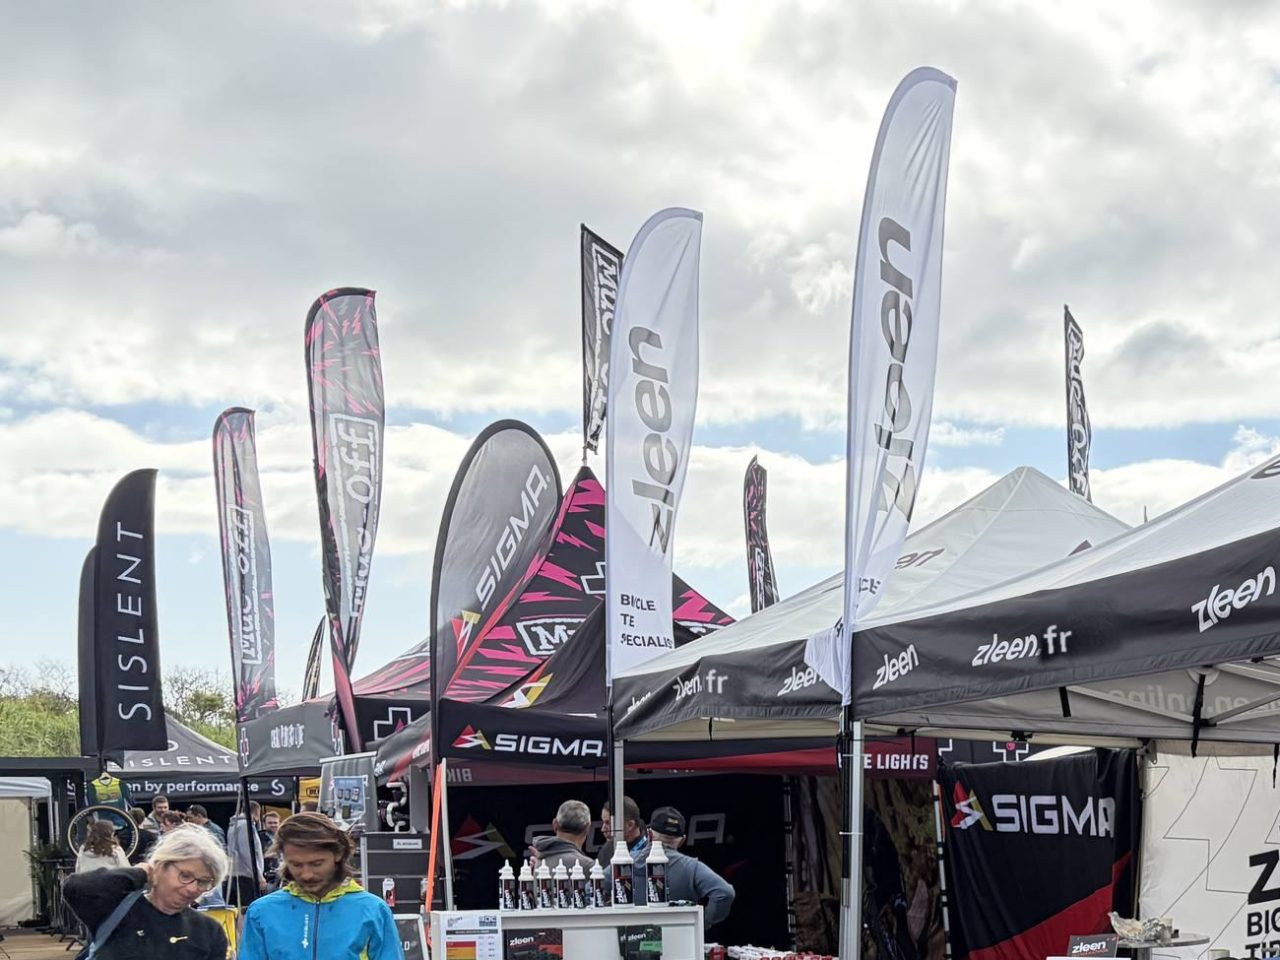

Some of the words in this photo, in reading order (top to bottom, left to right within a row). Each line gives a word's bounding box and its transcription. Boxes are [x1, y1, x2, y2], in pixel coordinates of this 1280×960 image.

[876, 216, 920, 524] zleen
[628, 325, 680, 554] zleen
[475, 464, 550, 610] SIGMA
[1191, 565, 1276, 633] zleen
[117, 522, 152, 721] SISLENT
[873, 643, 920, 691] zleen
[971, 624, 1072, 668] zleen.fr
[494, 733, 603, 757] SIGMA
[877, 754, 929, 771] LIGHTS
[144, 781, 163, 795] by
[991, 793, 1116, 838] SIGMA
[510, 935, 535, 947] zleen
[627, 932, 647, 942] zleen
[1072, 940, 1107, 954] zleen
